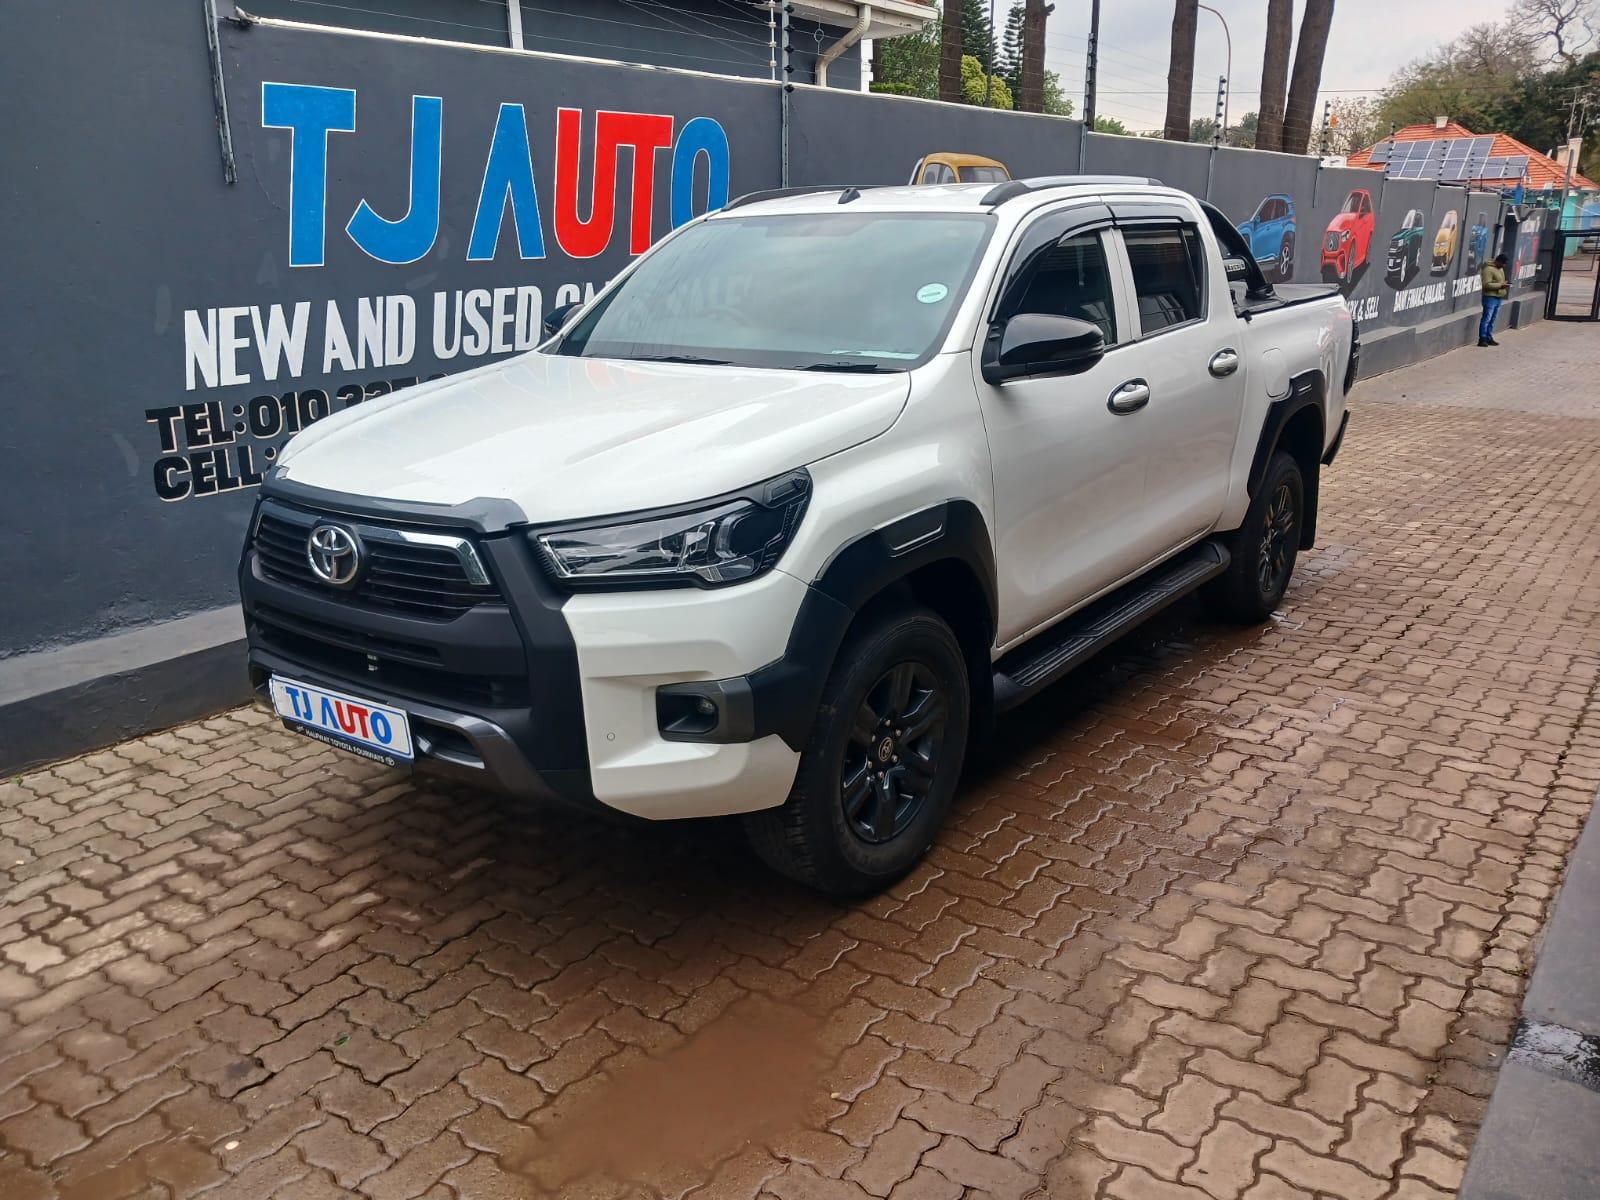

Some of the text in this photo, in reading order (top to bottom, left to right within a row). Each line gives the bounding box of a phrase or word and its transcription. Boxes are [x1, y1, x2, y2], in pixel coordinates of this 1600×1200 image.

[262, 81, 730, 267] TJ AUTO
[1365, 295, 1380, 320] SELL
[184, 285, 542, 390] NEW AND USED
[285, 686, 392, 744] TJ AUTO
[331, 739, 353, 753] TOYOTA
